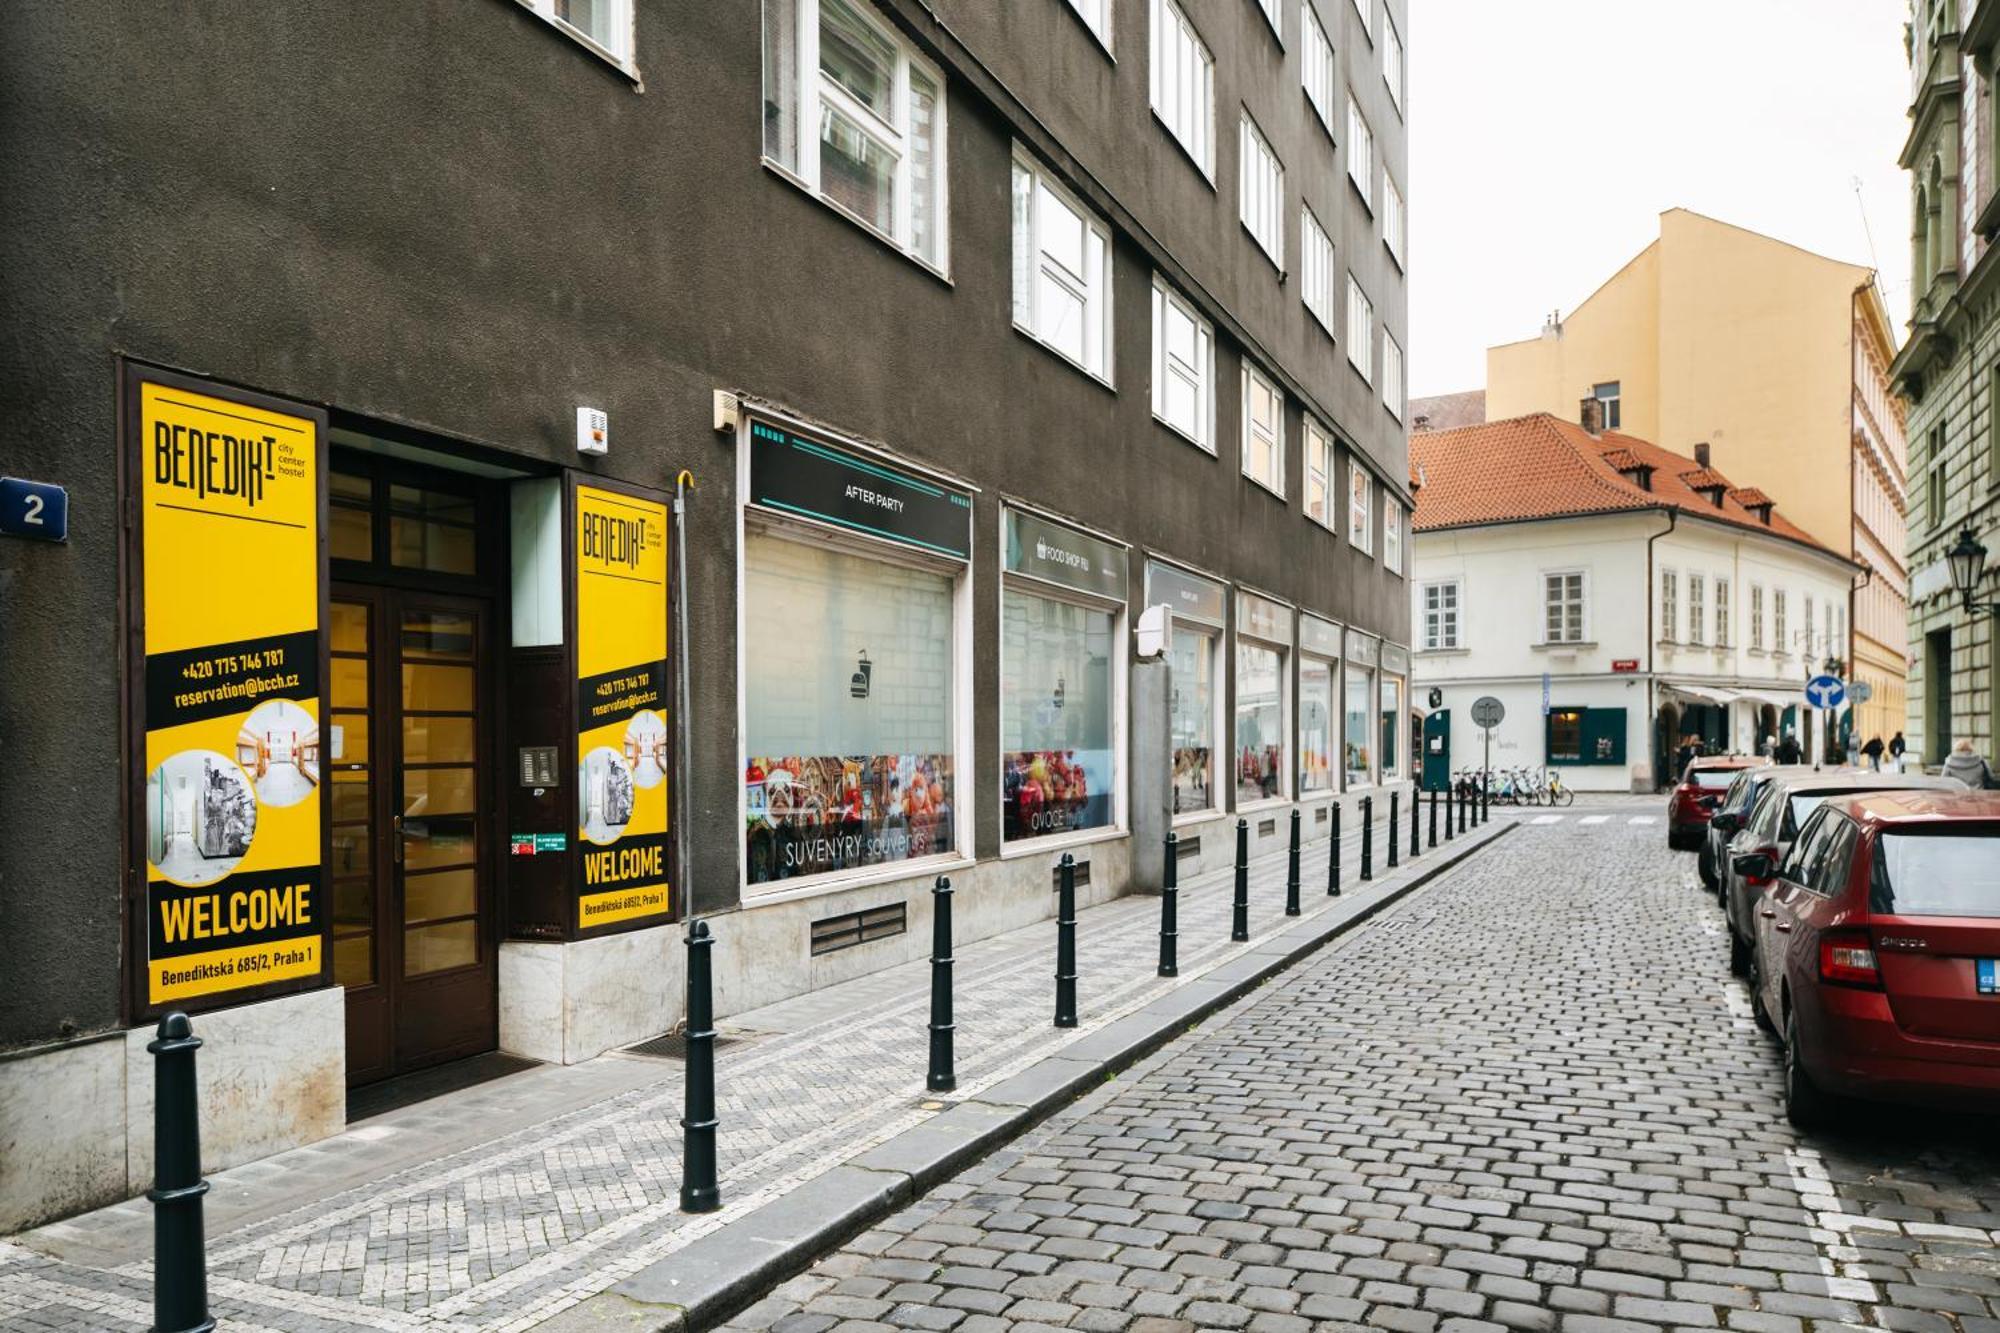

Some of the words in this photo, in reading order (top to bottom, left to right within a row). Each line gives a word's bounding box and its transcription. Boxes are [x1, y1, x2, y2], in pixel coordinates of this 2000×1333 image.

[278, 443, 294, 455] city
[278, 455, 305, 467] center
[278, 464, 305, 478] hostel
[24, 494, 44, 525] 2
[845, 484, 876, 505] AFTER
[876, 494, 904, 513] PARTY
[182, 660, 213, 680] +420
[215, 656, 238, 676] 775
[240, 653, 262, 671] 746
[263, 649, 284, 667] 787
[174, 673, 300, 709] reservation@bcch.cz
[785, 830, 863, 867] SUVENÝRY
[584, 846, 663, 885] WELCOME
[160, 884, 311, 943] WELCOME
[642, 894, 660, 906] Praha
[162, 958, 234, 985] Benediktská
[236, 954, 271, 973] 685/2,
[274, 950, 305, 967] Praha
[306, 947, 312, 961] 1
